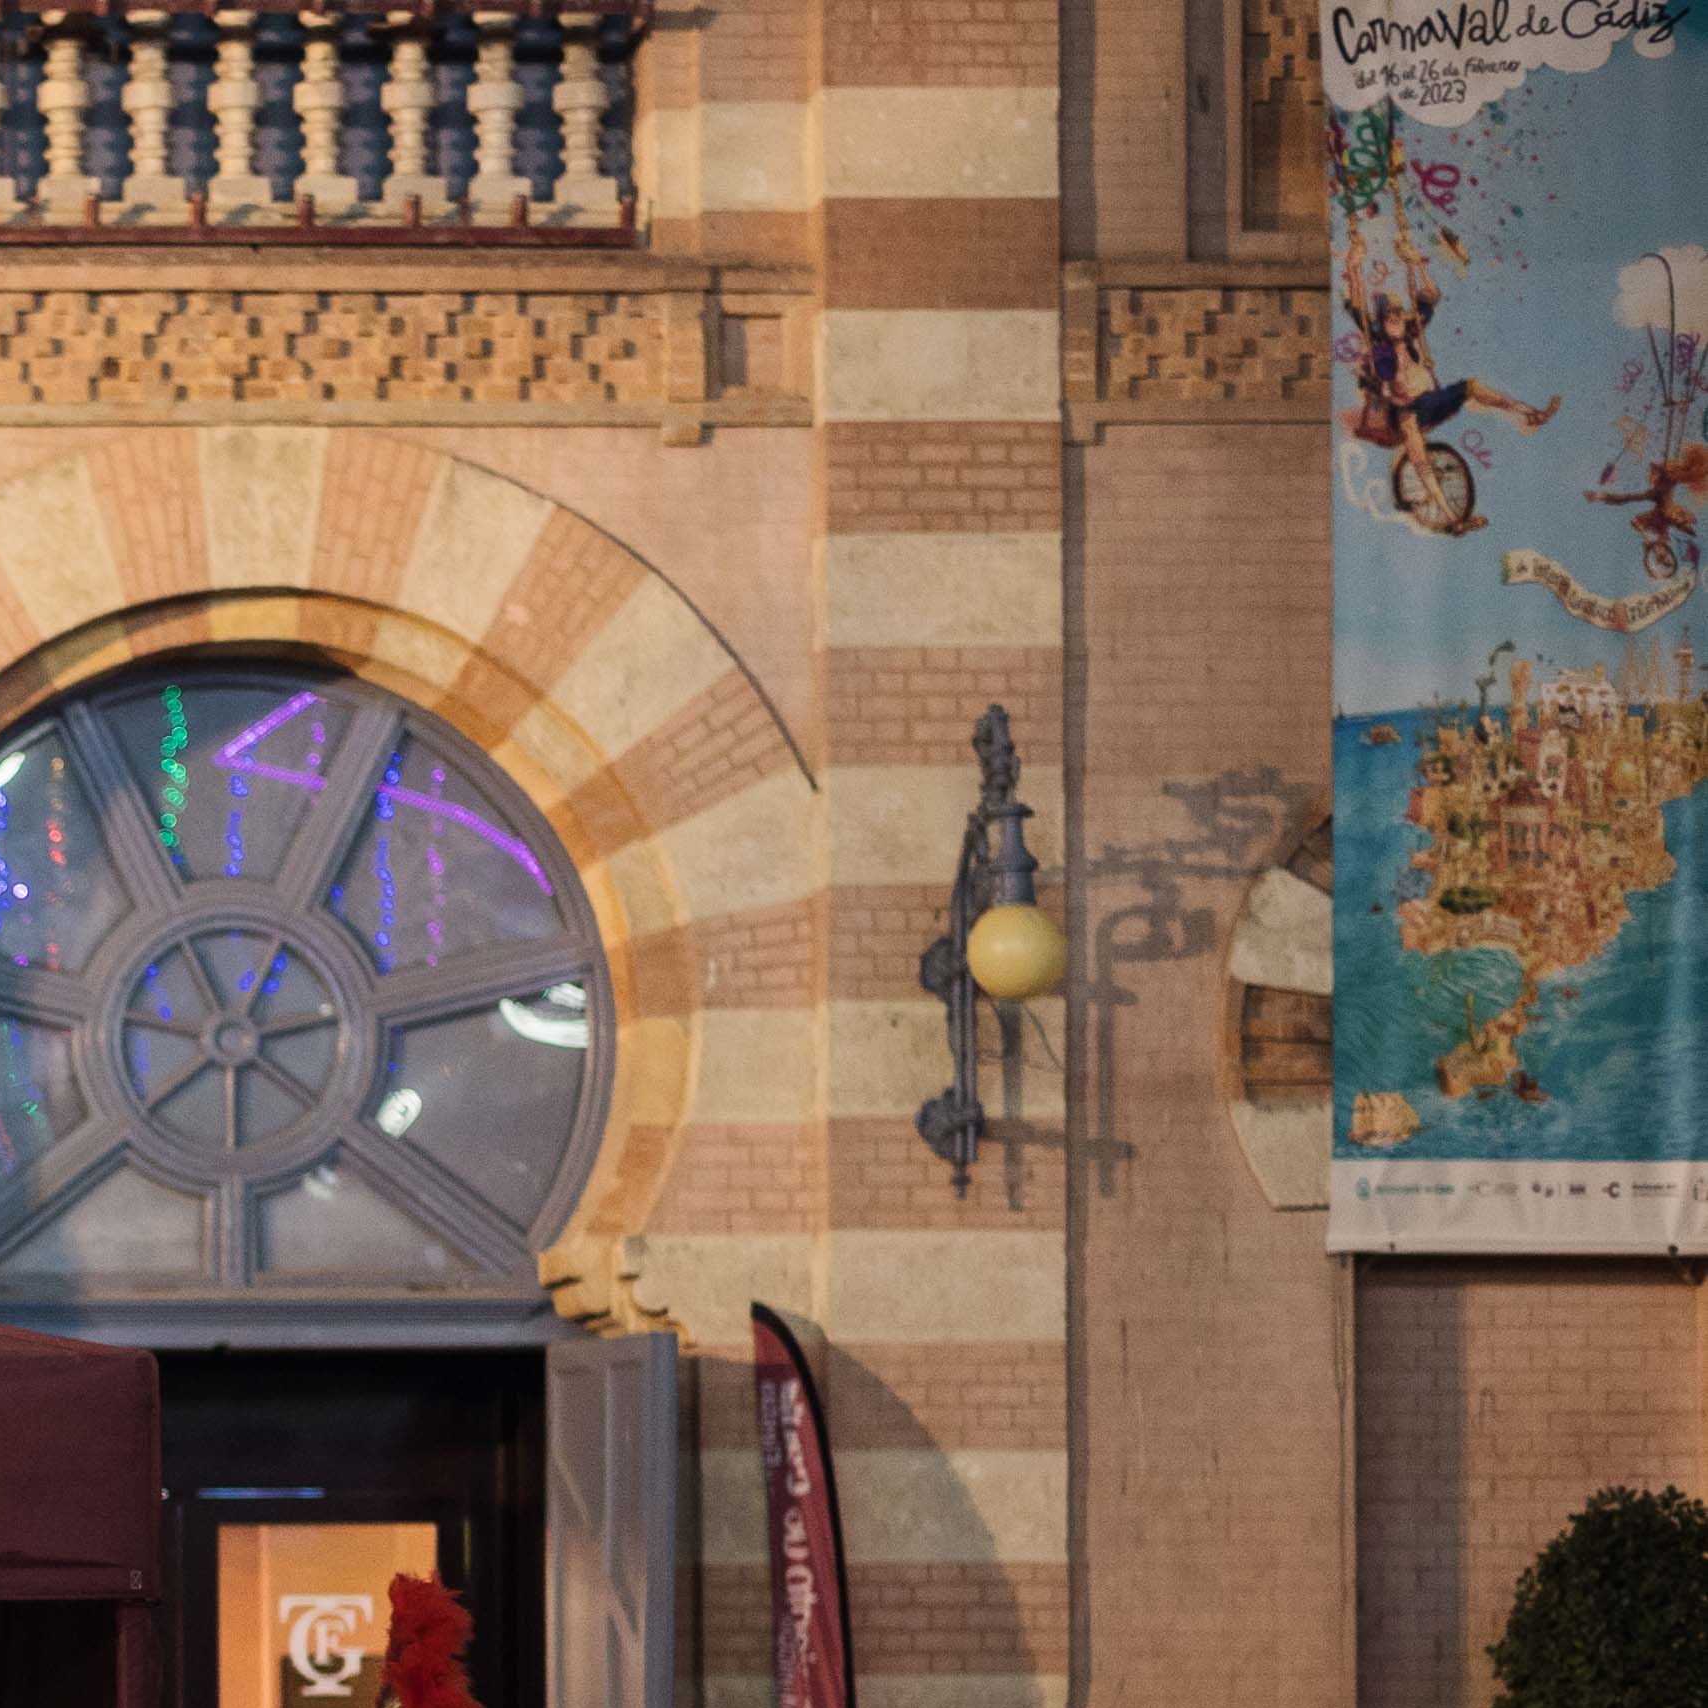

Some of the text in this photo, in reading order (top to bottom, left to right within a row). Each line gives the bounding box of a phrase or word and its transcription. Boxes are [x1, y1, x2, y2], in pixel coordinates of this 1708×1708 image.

[1333, 0, 1691, 64] CarnaVal de Cádiz
[1380, 62, 1400, 86] 16
[1419, 58, 1440, 84] 26
[1419, 79, 1467, 106] 2023
